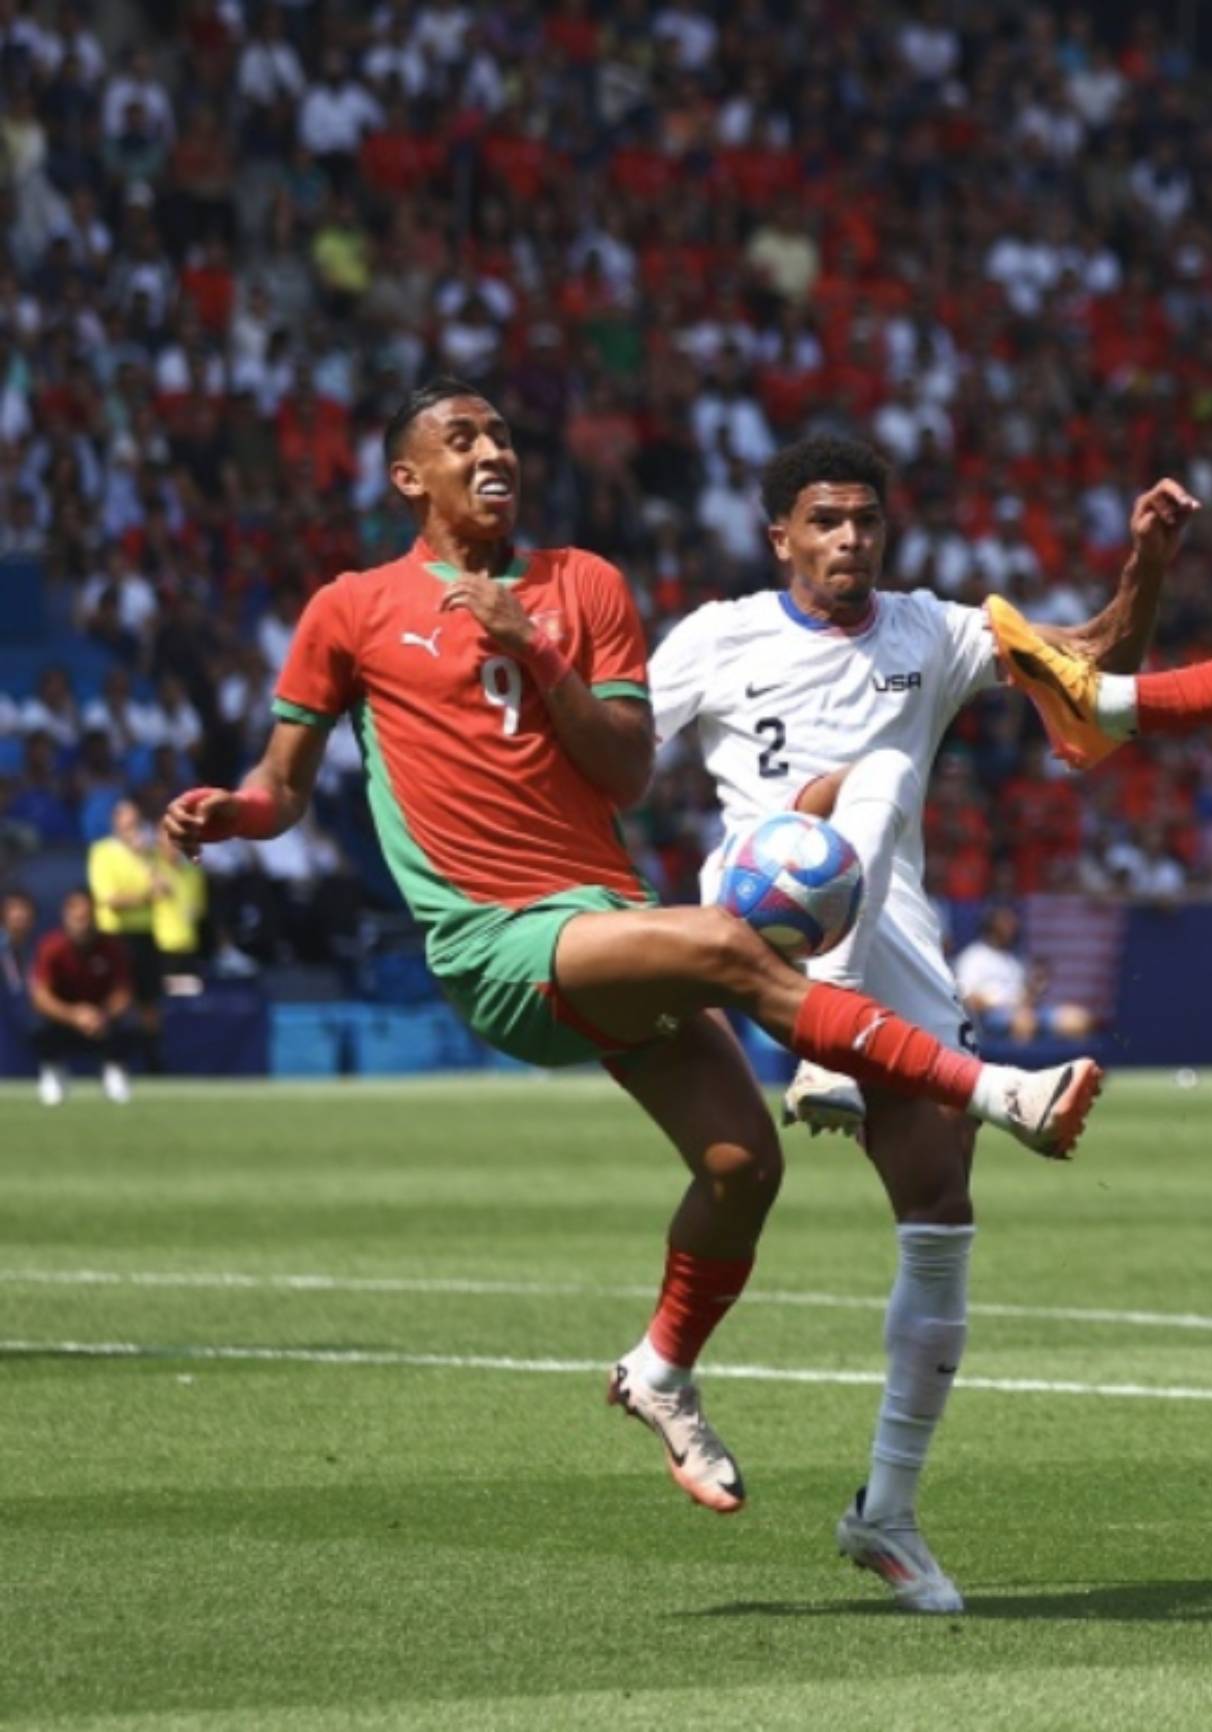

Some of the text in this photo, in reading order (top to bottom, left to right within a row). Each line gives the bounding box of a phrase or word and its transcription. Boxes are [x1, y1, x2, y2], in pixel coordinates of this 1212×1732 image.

[480, 656, 522, 736] 9
[872, 671, 922, 692] USA
[754, 717, 789, 778] 2
